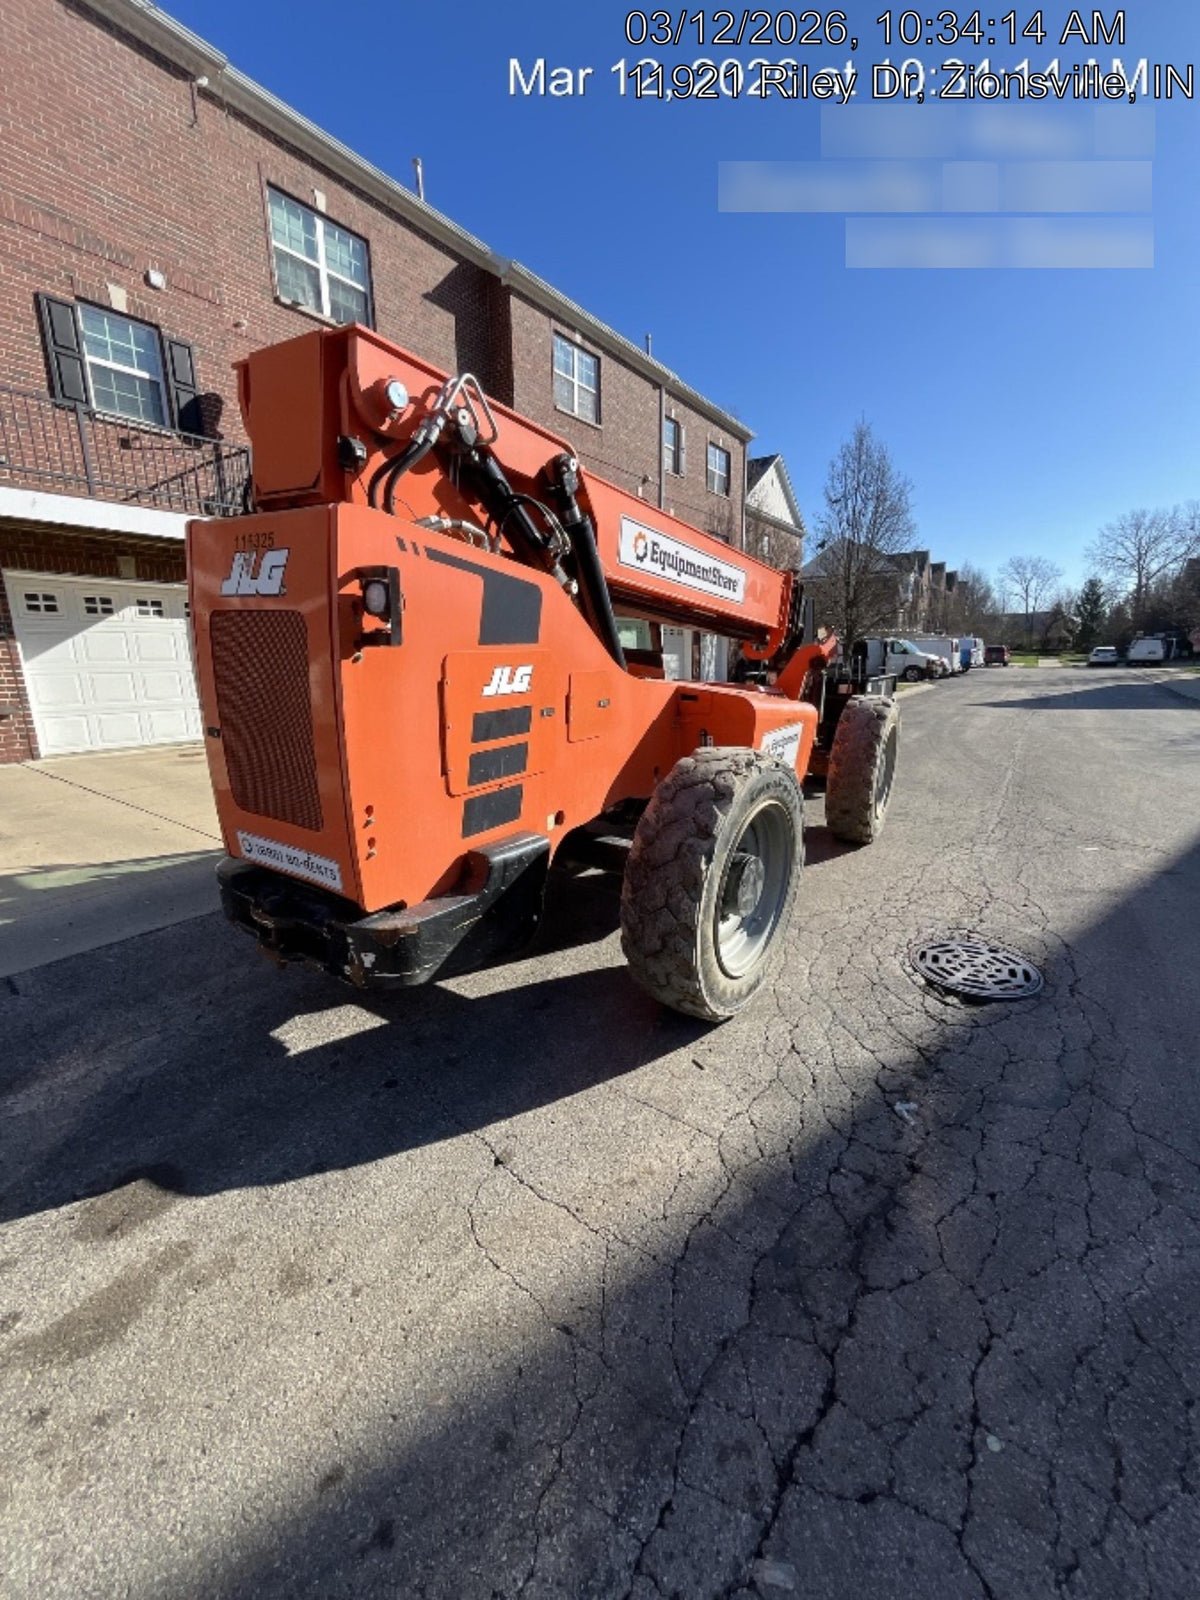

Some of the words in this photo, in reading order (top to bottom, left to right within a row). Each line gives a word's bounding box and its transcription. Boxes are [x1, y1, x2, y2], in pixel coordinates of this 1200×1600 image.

[220, 548, 290, 597] JLG
[650, 540, 739, 593] EquipmentShare
[481, 664, 534, 697] JLG
